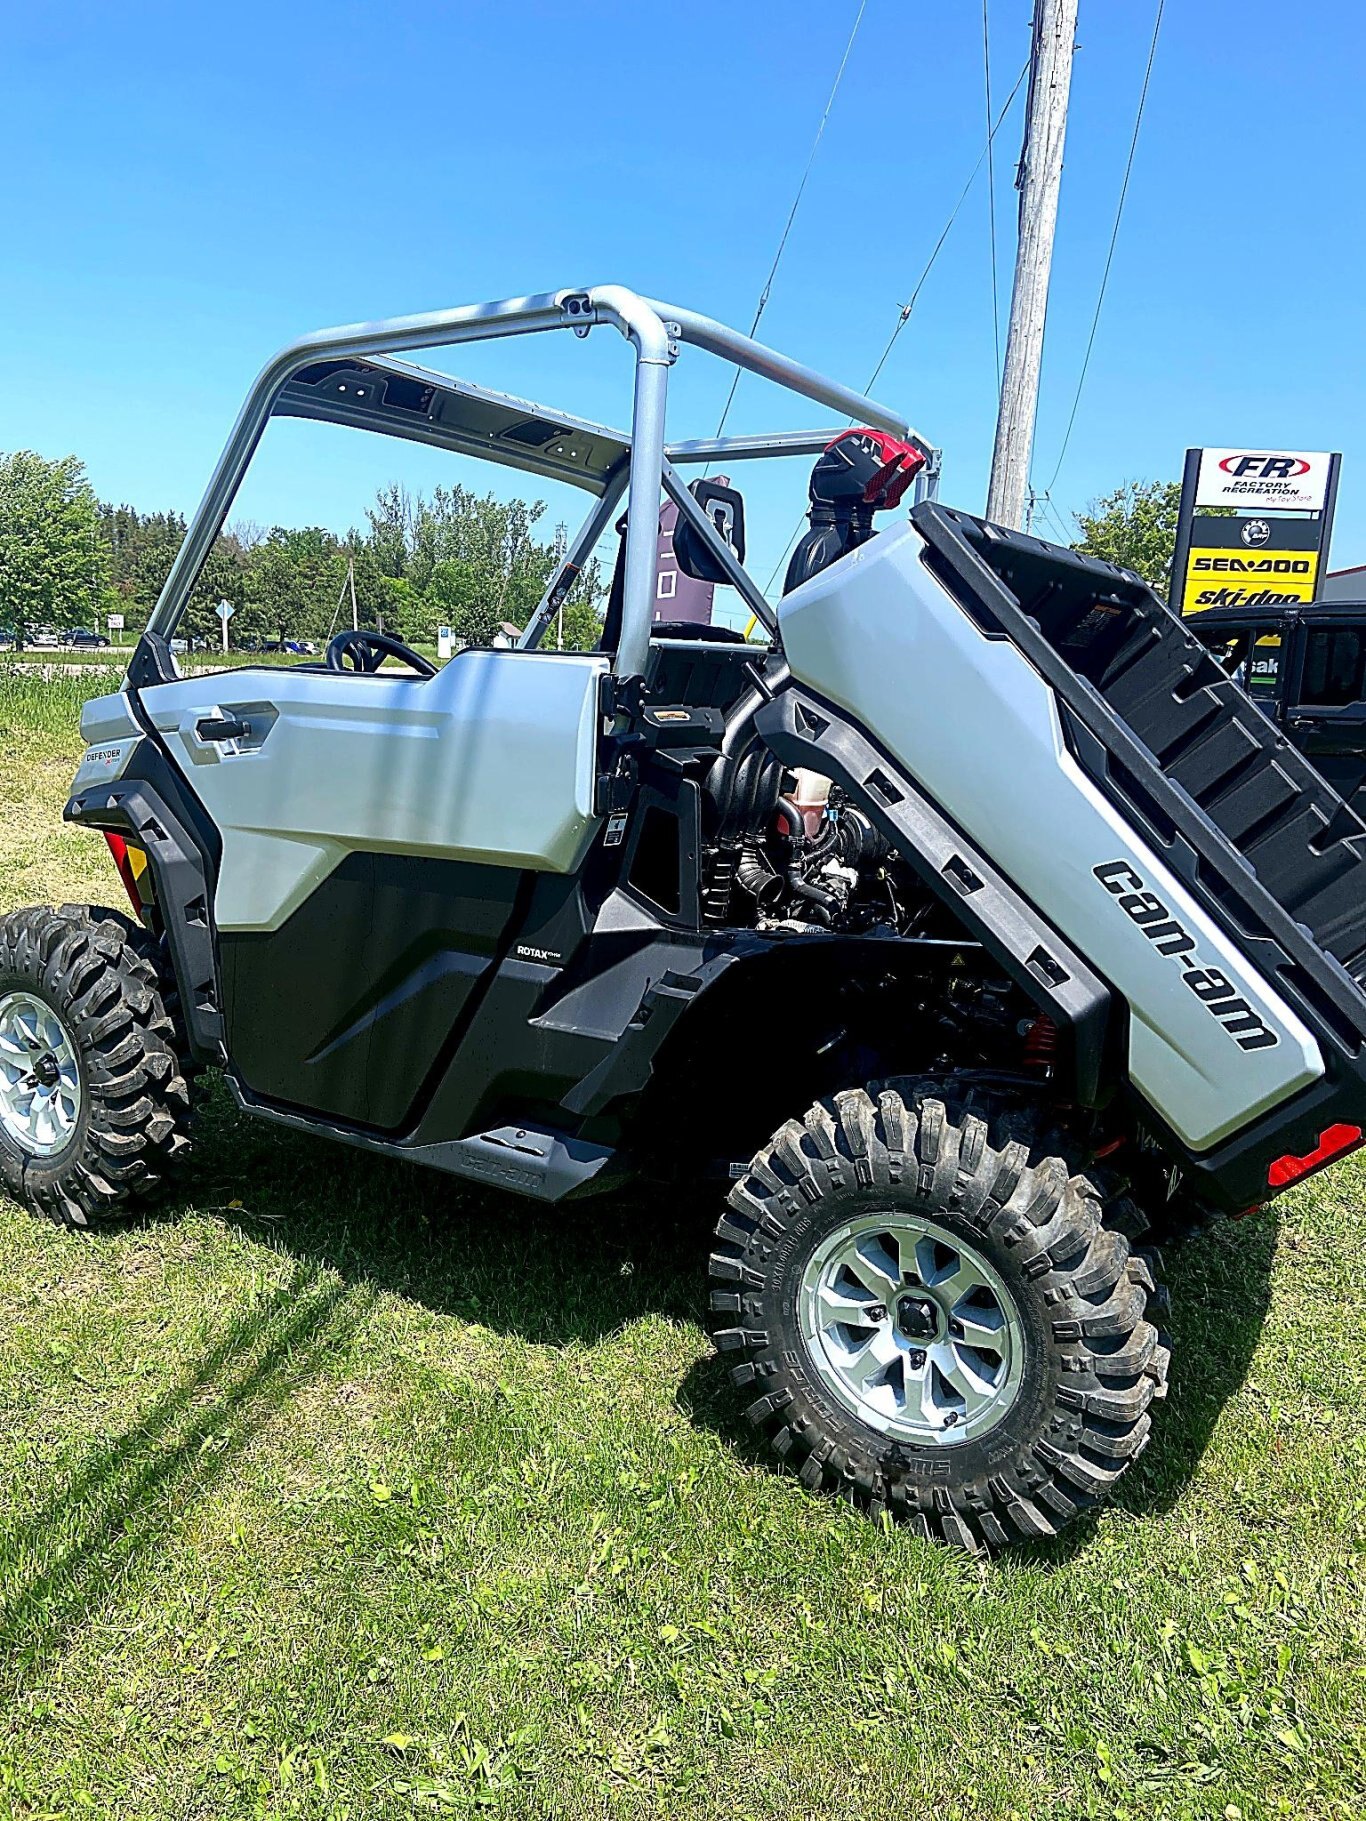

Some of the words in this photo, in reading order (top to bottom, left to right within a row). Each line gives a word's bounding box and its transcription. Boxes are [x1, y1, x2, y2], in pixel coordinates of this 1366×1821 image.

[1231, 457, 1296, 478] FR
[1222, 487, 1300, 495] RECREATION
[86, 749, 121, 762] DEFENDER
[517, 945, 548, 960] ROTAX
[1092, 859, 1279, 1052] can-am
